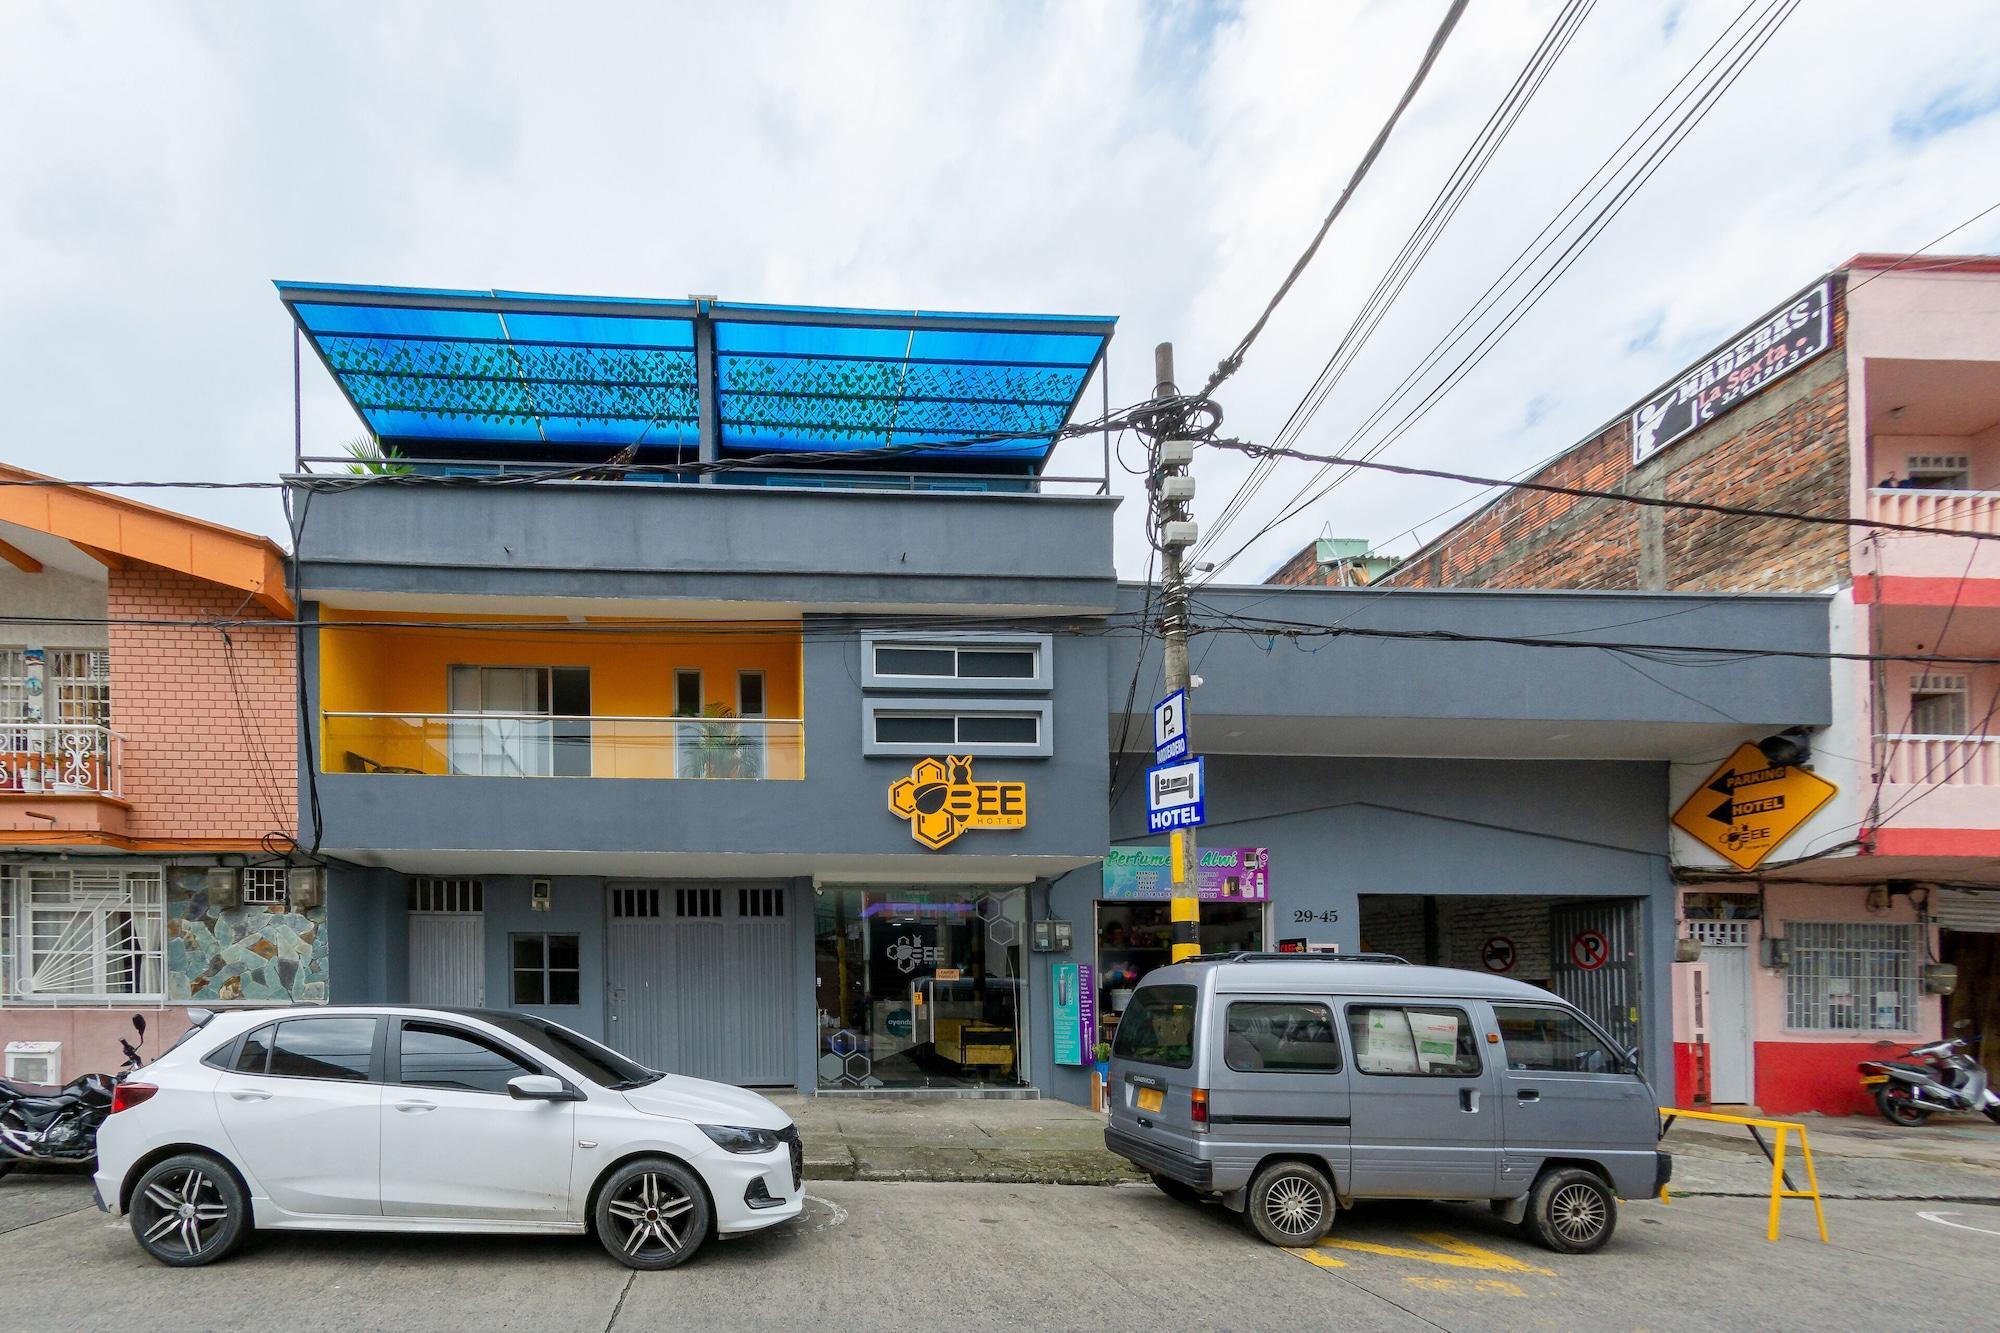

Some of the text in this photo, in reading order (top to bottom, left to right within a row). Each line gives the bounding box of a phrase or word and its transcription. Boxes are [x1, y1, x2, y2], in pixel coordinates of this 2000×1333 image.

[1698, 342, 1789, 410] La Sexta
[1163, 704, 1173, 739] P
[1726, 766, 1785, 788] PARKING
[951, 785, 1024, 815] BEE
[1732, 797, 1784, 817] HOTEL
[1151, 806, 1201, 829] HOTEL
[1294, 910, 1338, 922] 29-45
[1584, 937, 1600, 961] P
